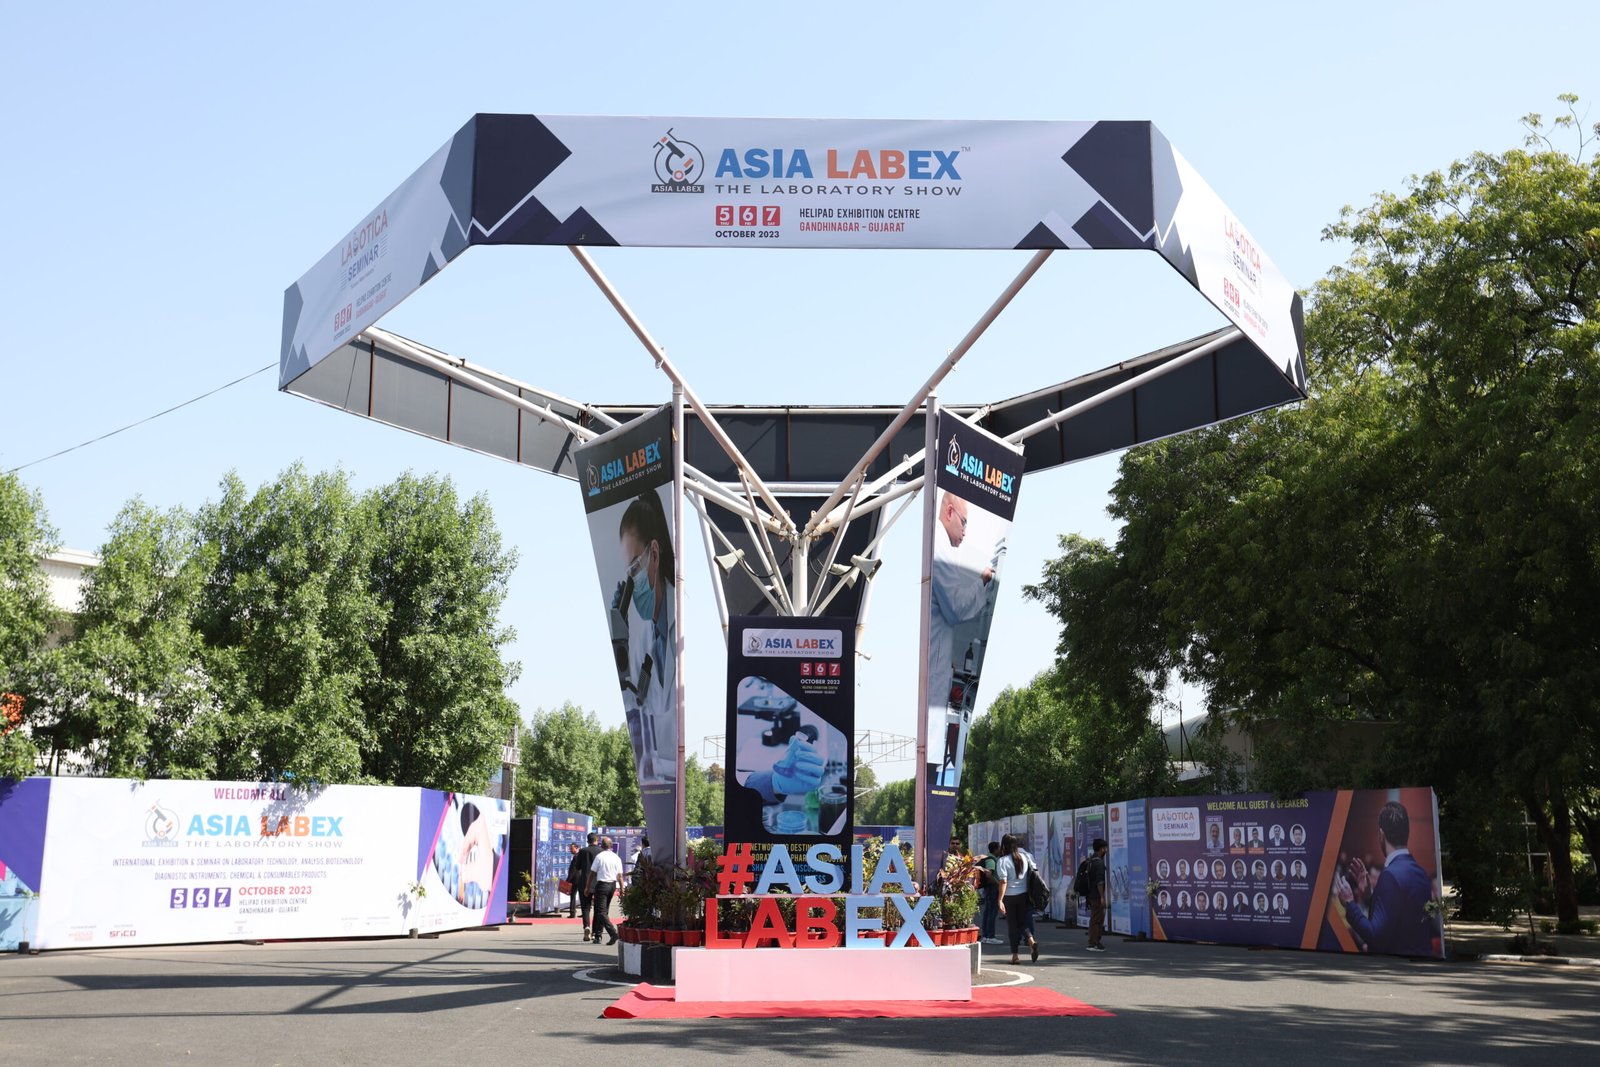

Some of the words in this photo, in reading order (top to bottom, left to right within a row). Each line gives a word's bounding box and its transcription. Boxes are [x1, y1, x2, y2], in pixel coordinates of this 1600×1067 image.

[715, 148, 813, 178] ASIA
[827, 149, 962, 180] LABEX
[715, 184, 752, 194] THE
[761, 185, 895, 195] LABORATORY
[904, 186, 962, 196] SHOW
[799, 208, 834, 218] HELIPAD
[837, 208, 884, 218] EXHIBITION
[888, 209, 920, 219] CENTRE
[799, 222, 860, 232] GANDHINAGAR
[868, 222, 905, 232] GUJARAT
[348, 244, 380, 282] SEMINAR
[601, 458, 625, 483] ASIA
[626, 441, 661, 473] LABEX
[612, 472, 645, 490] LABORATORY
[646, 462, 662, 475] SHOW
[961, 452, 983, 480] ASIA
[985, 464, 1012, 494] LABEX
[960, 472, 969, 482] THE
[970, 478, 998, 497] LABORATORY
[999, 492, 1011, 502] SHOW
[765, 638, 792, 649] ASIA
[796, 639, 834, 650] LABEX
[214, 788, 266, 800] WELCOME
[269, 789, 286, 800] ALL
[1207, 801, 1236, 810] WELCOME
[1237, 801, 1248, 810] ALL
[1249, 800, 1268, 809] GUEST
[1270, 800, 1275, 808] &
[1277, 799, 1308, 808] SPEAKERS
[186, 814, 251, 836] ASIA
[260, 816, 344, 837] LABEX
[113, 858, 156, 867] INTERNATIONAL
[158, 858, 189, 866] EXHIBITION
[155, 872, 187, 880] DIAGNOSTIC
[230, 872, 255, 880] CHEMICAL
[239, 886, 285, 896] OCTOBER
[289, 886, 312, 895] 2023
[705, 896, 935, 948] LABEX
